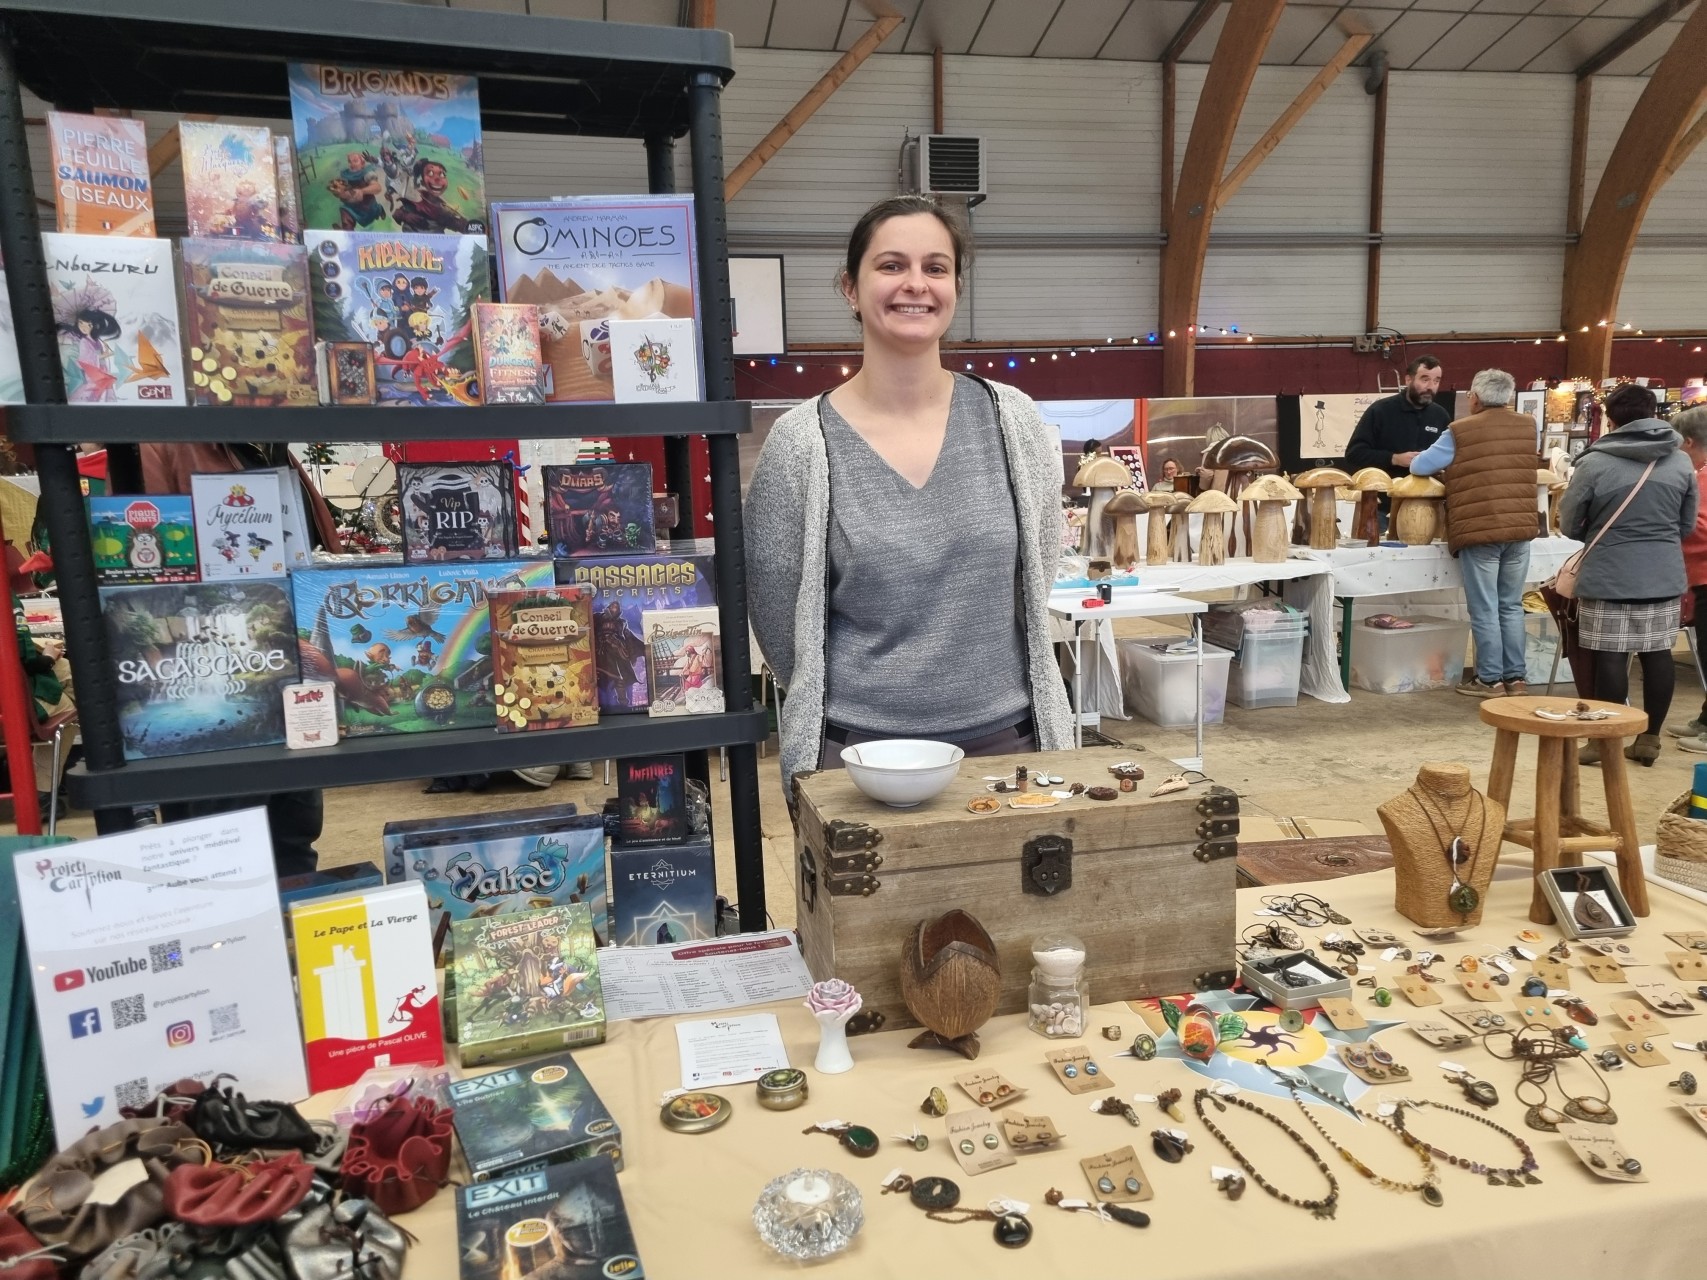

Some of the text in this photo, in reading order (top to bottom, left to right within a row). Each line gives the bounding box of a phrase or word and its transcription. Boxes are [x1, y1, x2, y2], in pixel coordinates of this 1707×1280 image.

[320, 66, 450, 99] BRIGANDS
[63, 128, 137, 156] PIERRE
[60, 146, 144, 175] FEUILLE
[58, 165, 147, 194] SAUMON
[60, 185, 150, 212] CISEAUX
[514, 217, 675, 255] OMINOES
[221, 266, 273, 282] Conseil
[212, 281, 290, 298] de Guerre
[489, 356, 536, 369] DUNGEON
[490, 368, 537, 379] FITNESS
[128, 509, 157, 517] PIQUE
[440, 497, 461, 511] Vip
[128, 515, 158, 523] POINTS
[436, 511, 474, 529] RIP
[575, 562, 697, 588] PASSAGES
[593, 586, 682, 598] ECRETS
[521, 610, 562, 623] Conseil
[512, 623, 577, 636] de Guerre
[35, 858, 82, 880] Projet
[629, 869, 697, 881] ETERNITIUM
[313, 914, 418, 938] Le Pape et La Vierge
[490, 916, 559, 940] FOREST LEADER
[85, 957, 148, 984] YouTube
[328, 1031, 428, 1058] Une pièce de Pascal OLIVE
[456, 1071, 513, 1095] EXIT
[471, 1176, 538, 1201] EXIT
[468, 1191, 560, 1219] Le Château Interdit
